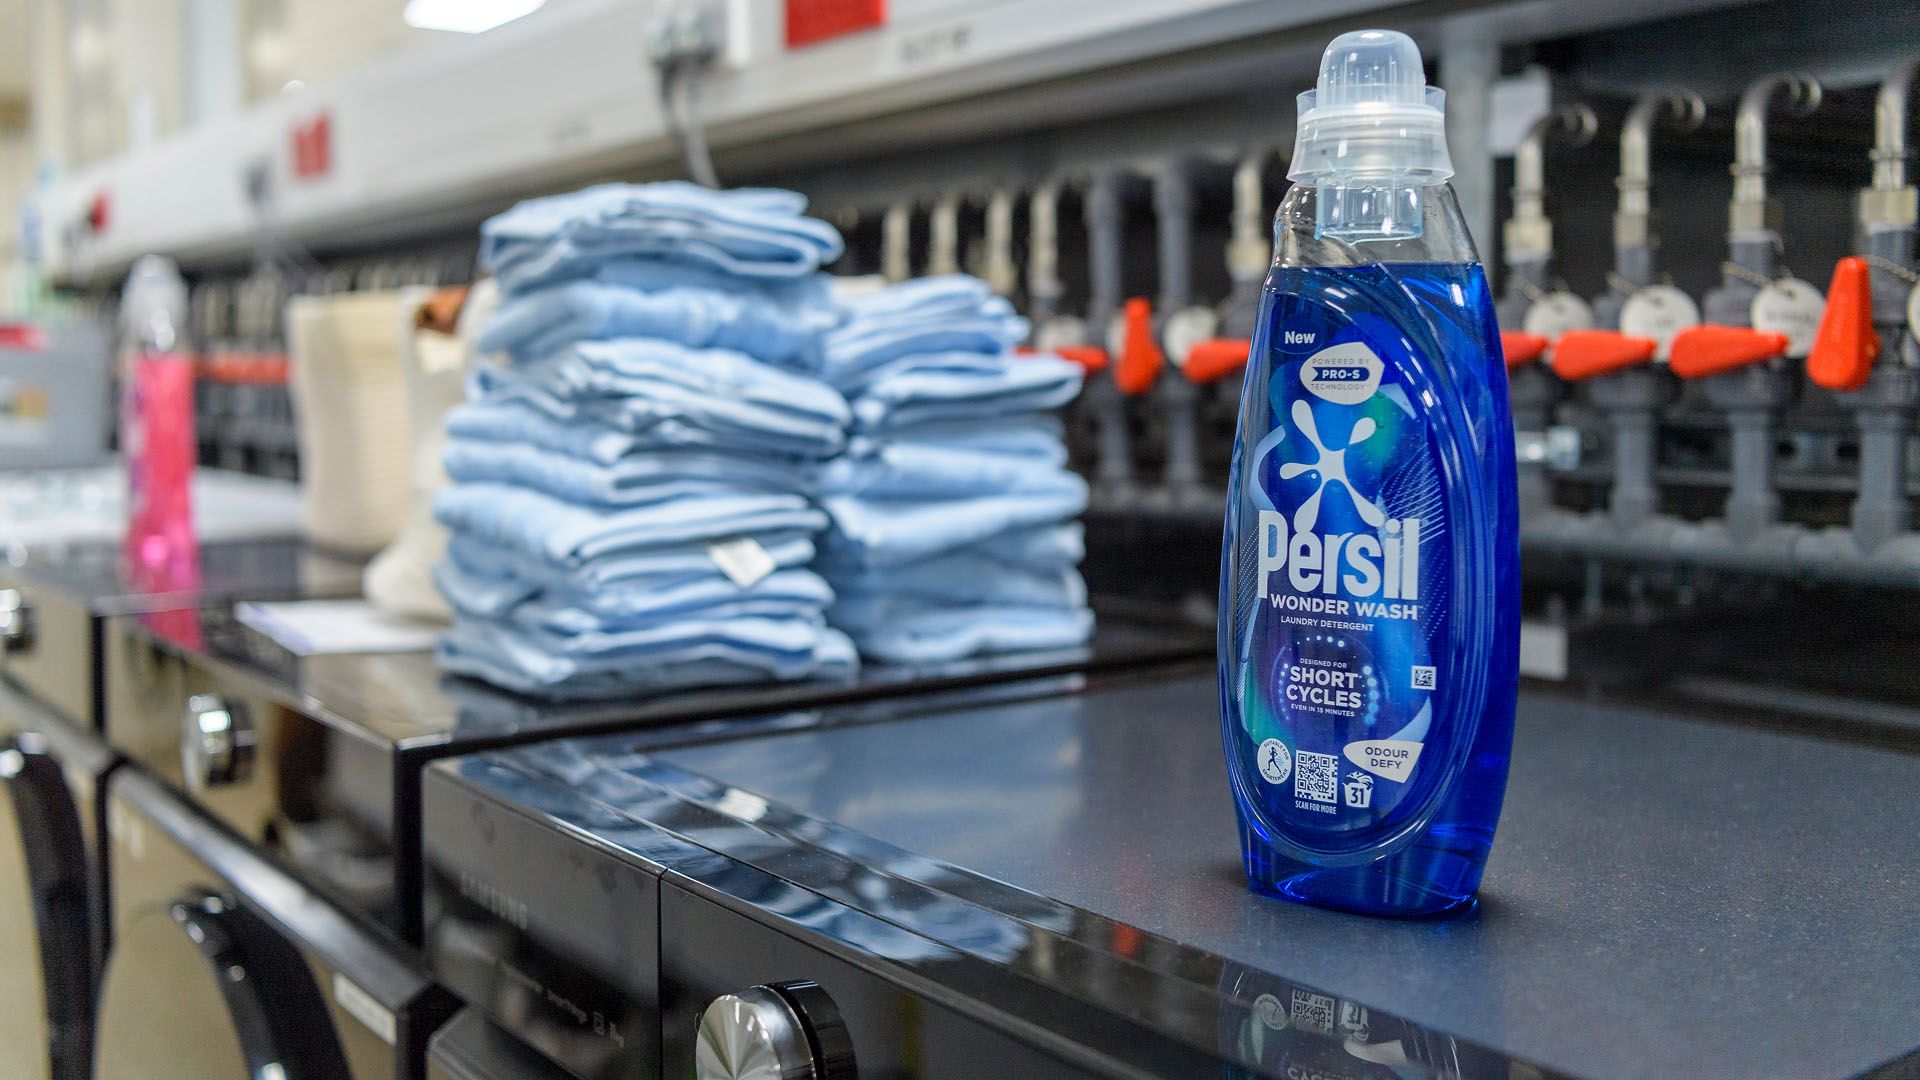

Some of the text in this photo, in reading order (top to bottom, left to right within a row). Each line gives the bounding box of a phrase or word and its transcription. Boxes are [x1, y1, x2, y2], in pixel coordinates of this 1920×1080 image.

[1284, 331, 1316, 344] New
[1321, 369, 1361, 380] PRO-S
[1311, 383, 1365, 391] TECHNOLOGY
[1258, 509, 1420, 600] Persil
[1270, 593, 1418, 620] WONDER WASH
[1280, 615, 1374, 632] LAUNDRY DETERGENT
[1300, 657, 1347, 669] DESIGNED FOR
[1290, 666, 1359, 689] SHORT
[1286, 684, 1362, 709] CYCLES
[1291, 703, 1307, 712] EVEN
[1325, 708, 1355, 717] MINUTES
[1365, 746, 1409, 759] ODOUR
[1371, 758, 1403, 769] DEFY
[1350, 787, 1365, 804] 31
[1295, 800, 1336, 815] SCAN FOR MORE
